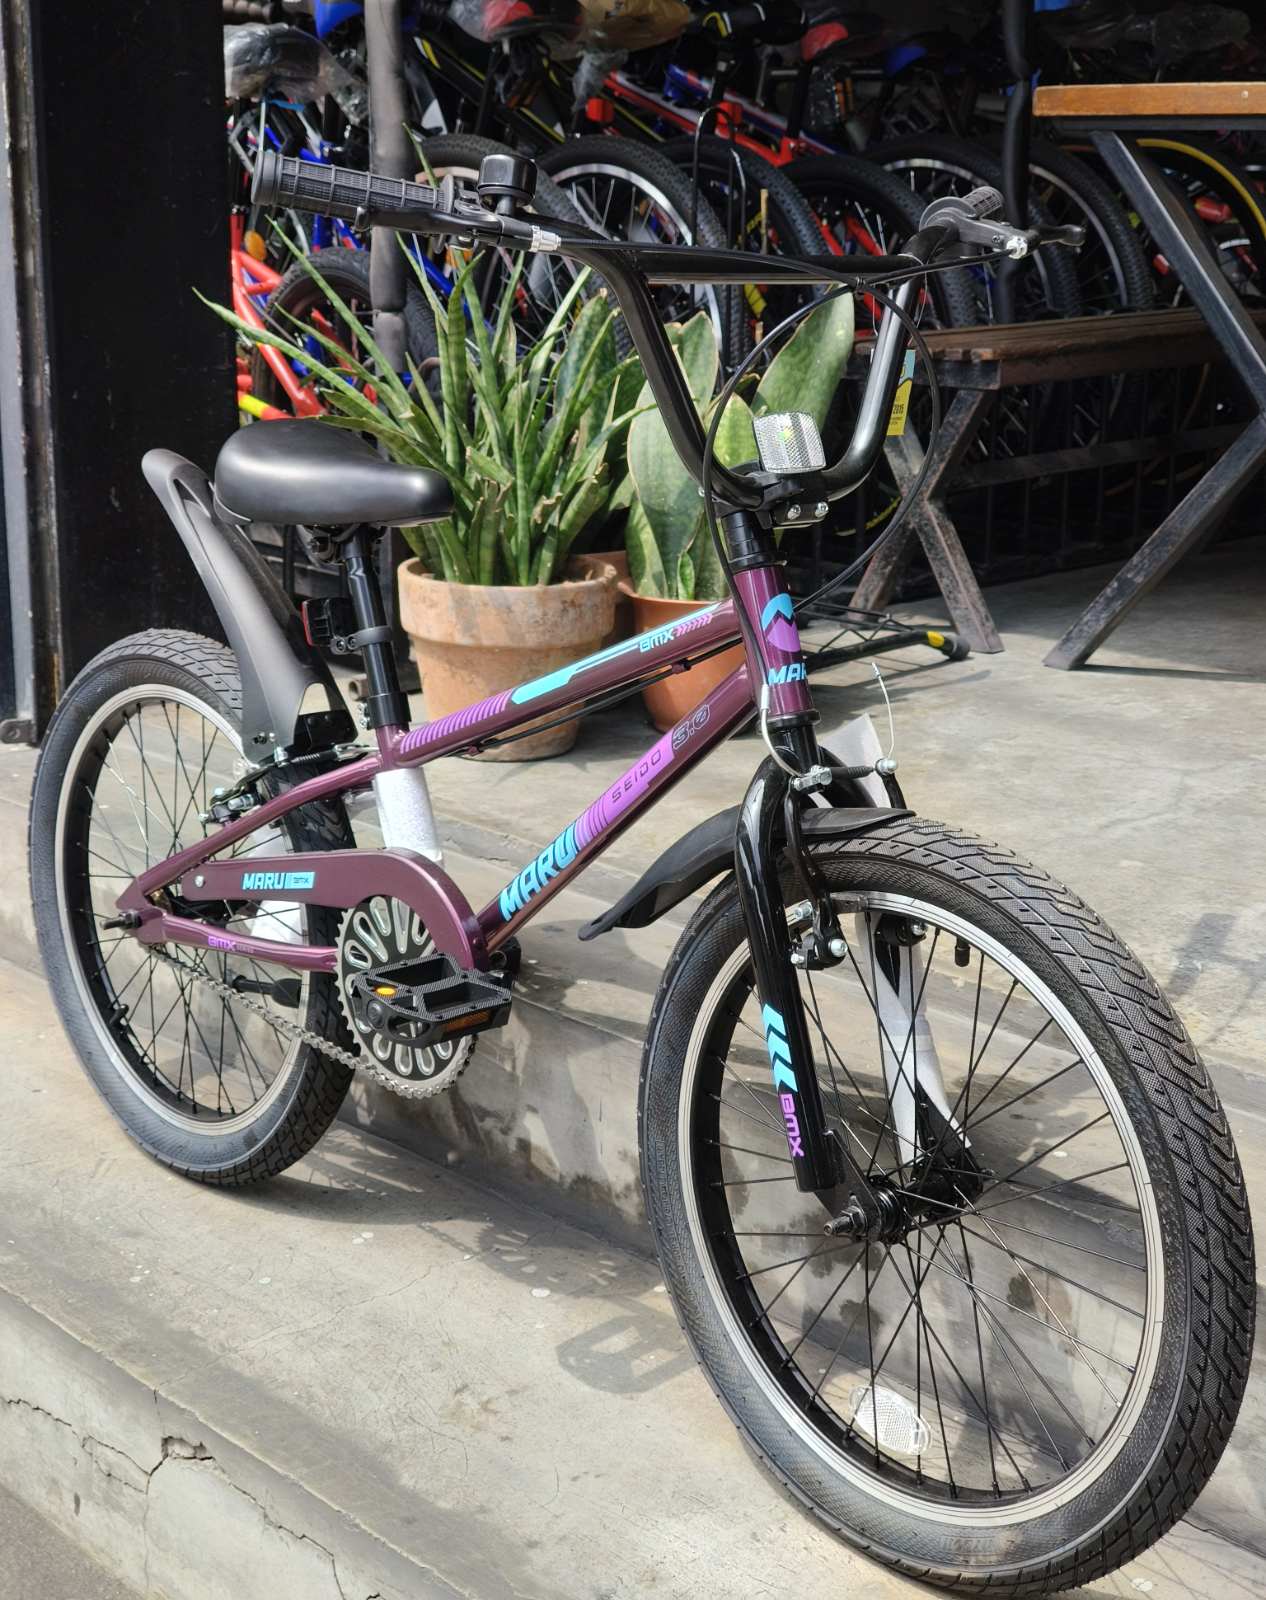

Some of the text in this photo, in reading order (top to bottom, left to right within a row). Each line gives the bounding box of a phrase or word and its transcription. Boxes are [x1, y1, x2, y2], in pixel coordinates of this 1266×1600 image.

[242, 872, 286, 890] MARU
[499, 822, 577, 922] MARU
[612, 750, 662, 802] SEIDO
